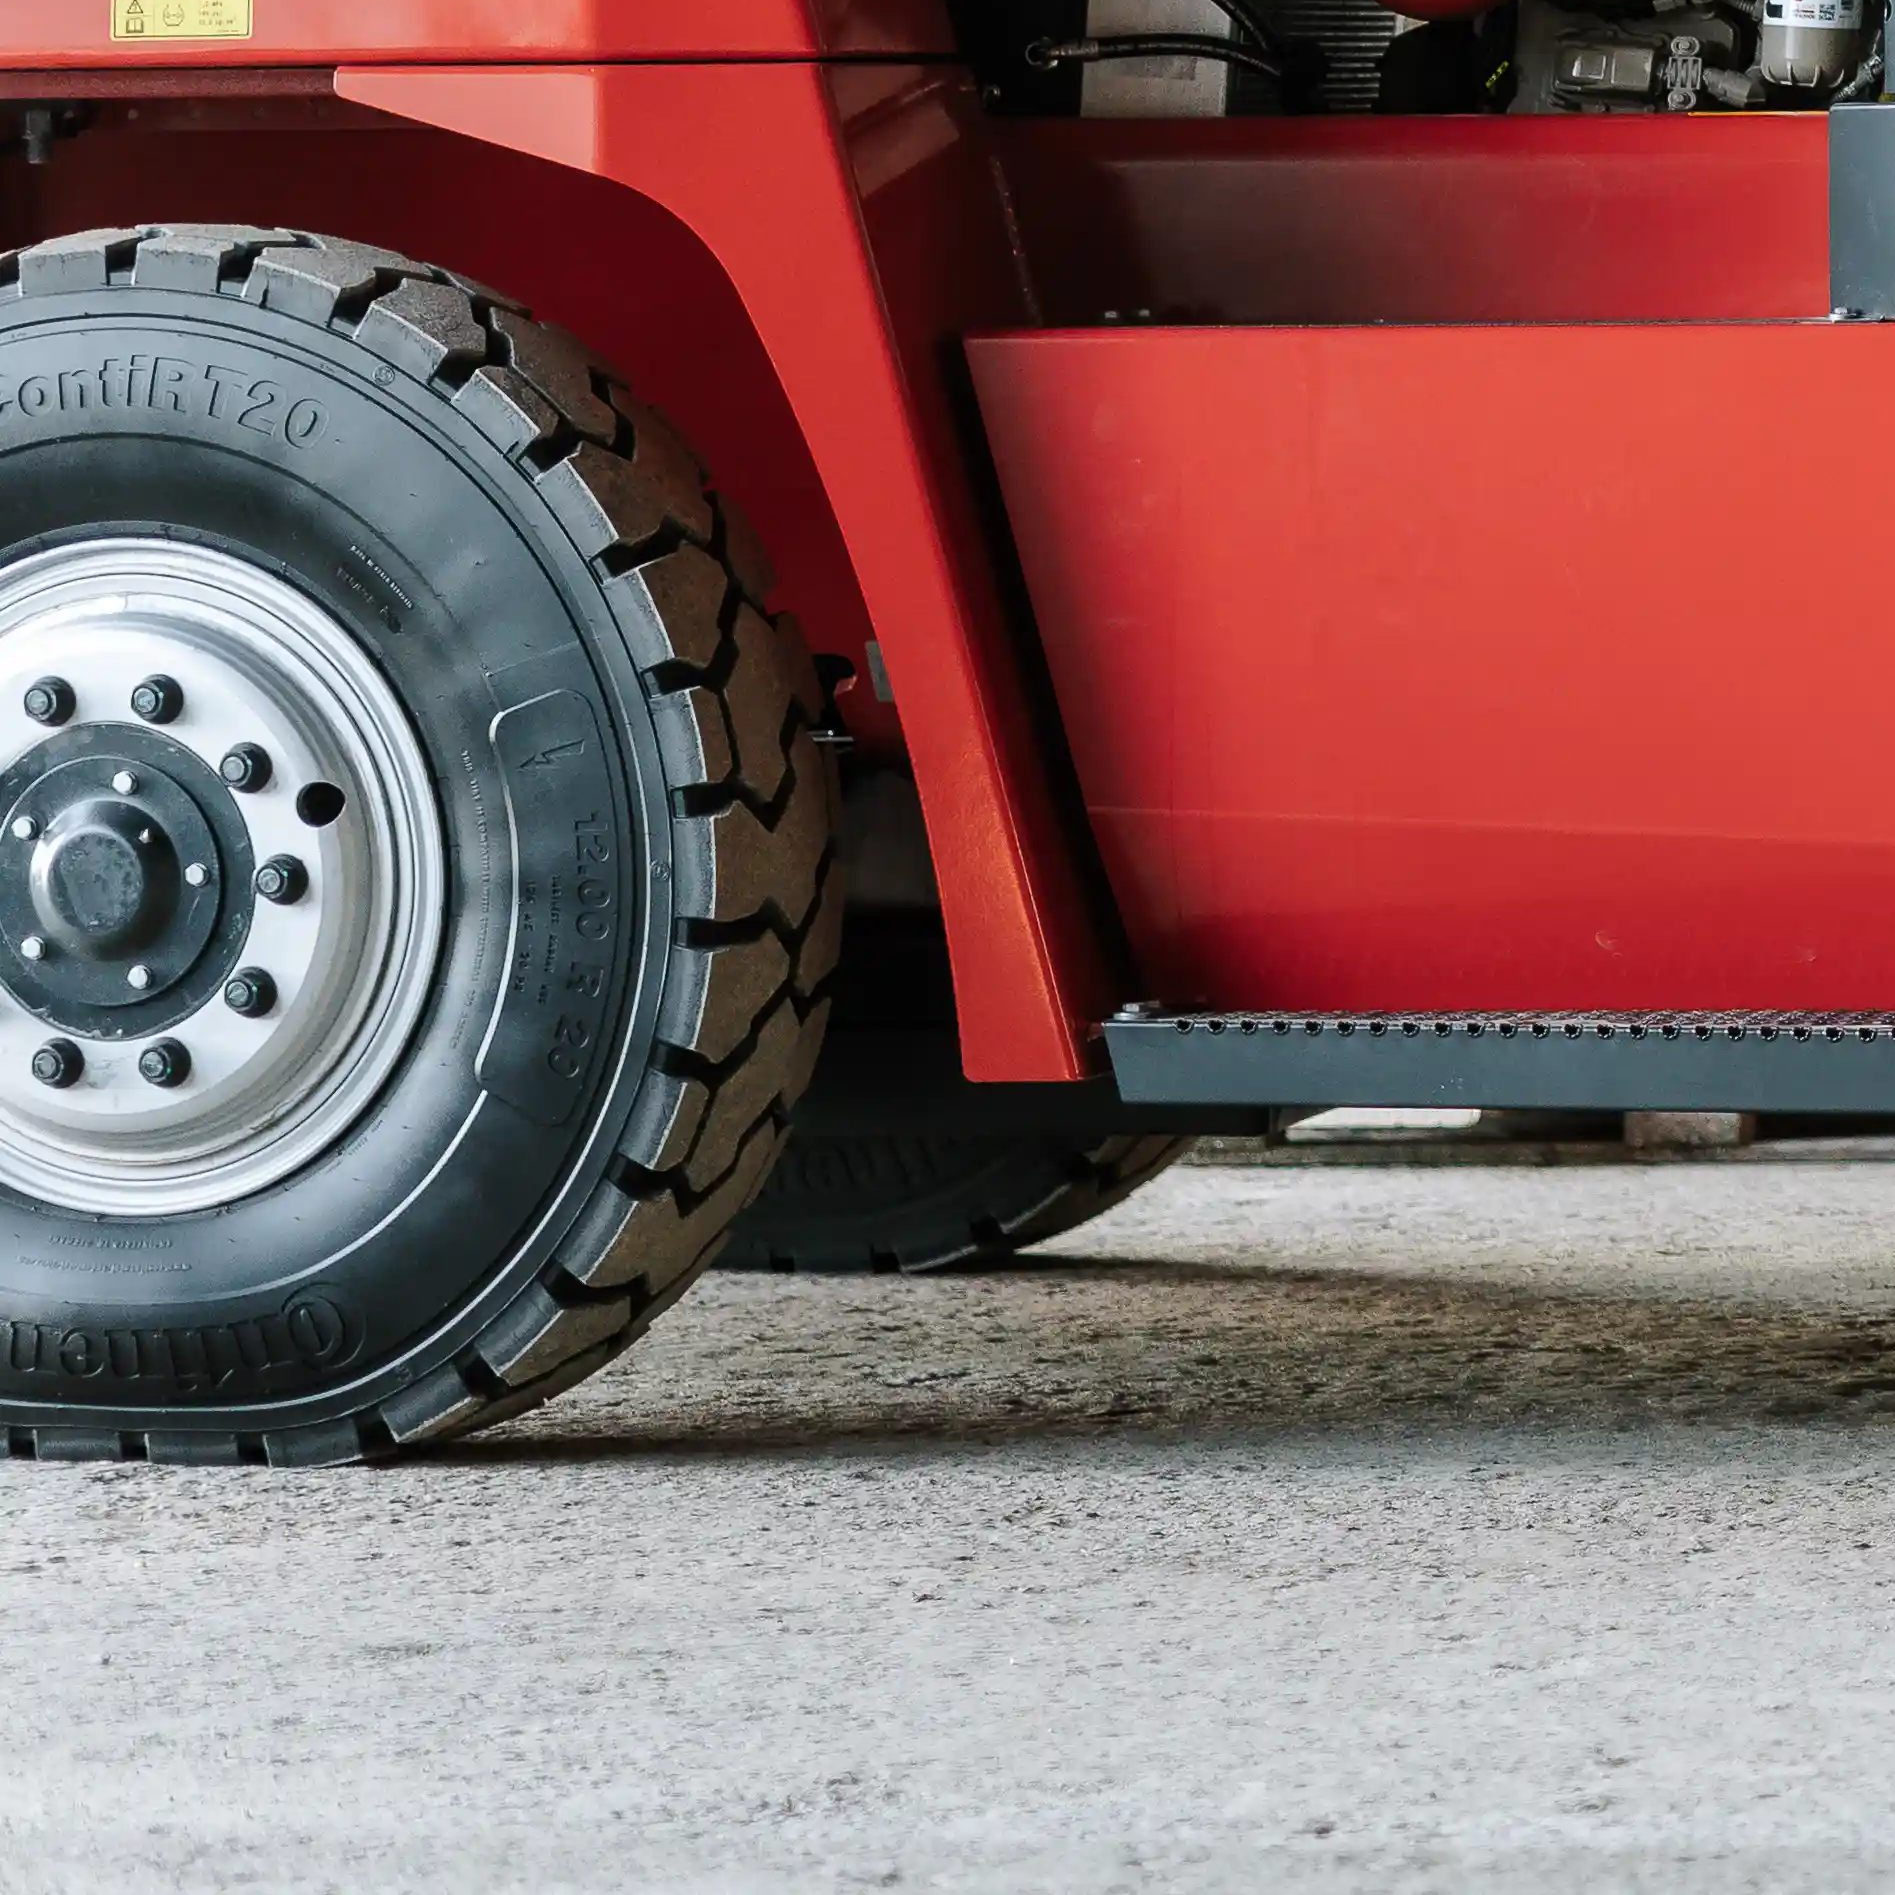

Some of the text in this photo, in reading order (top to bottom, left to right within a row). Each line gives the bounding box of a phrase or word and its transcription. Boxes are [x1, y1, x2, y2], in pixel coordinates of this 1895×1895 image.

[547, 810, 612, 1080] 12.00 R 20
